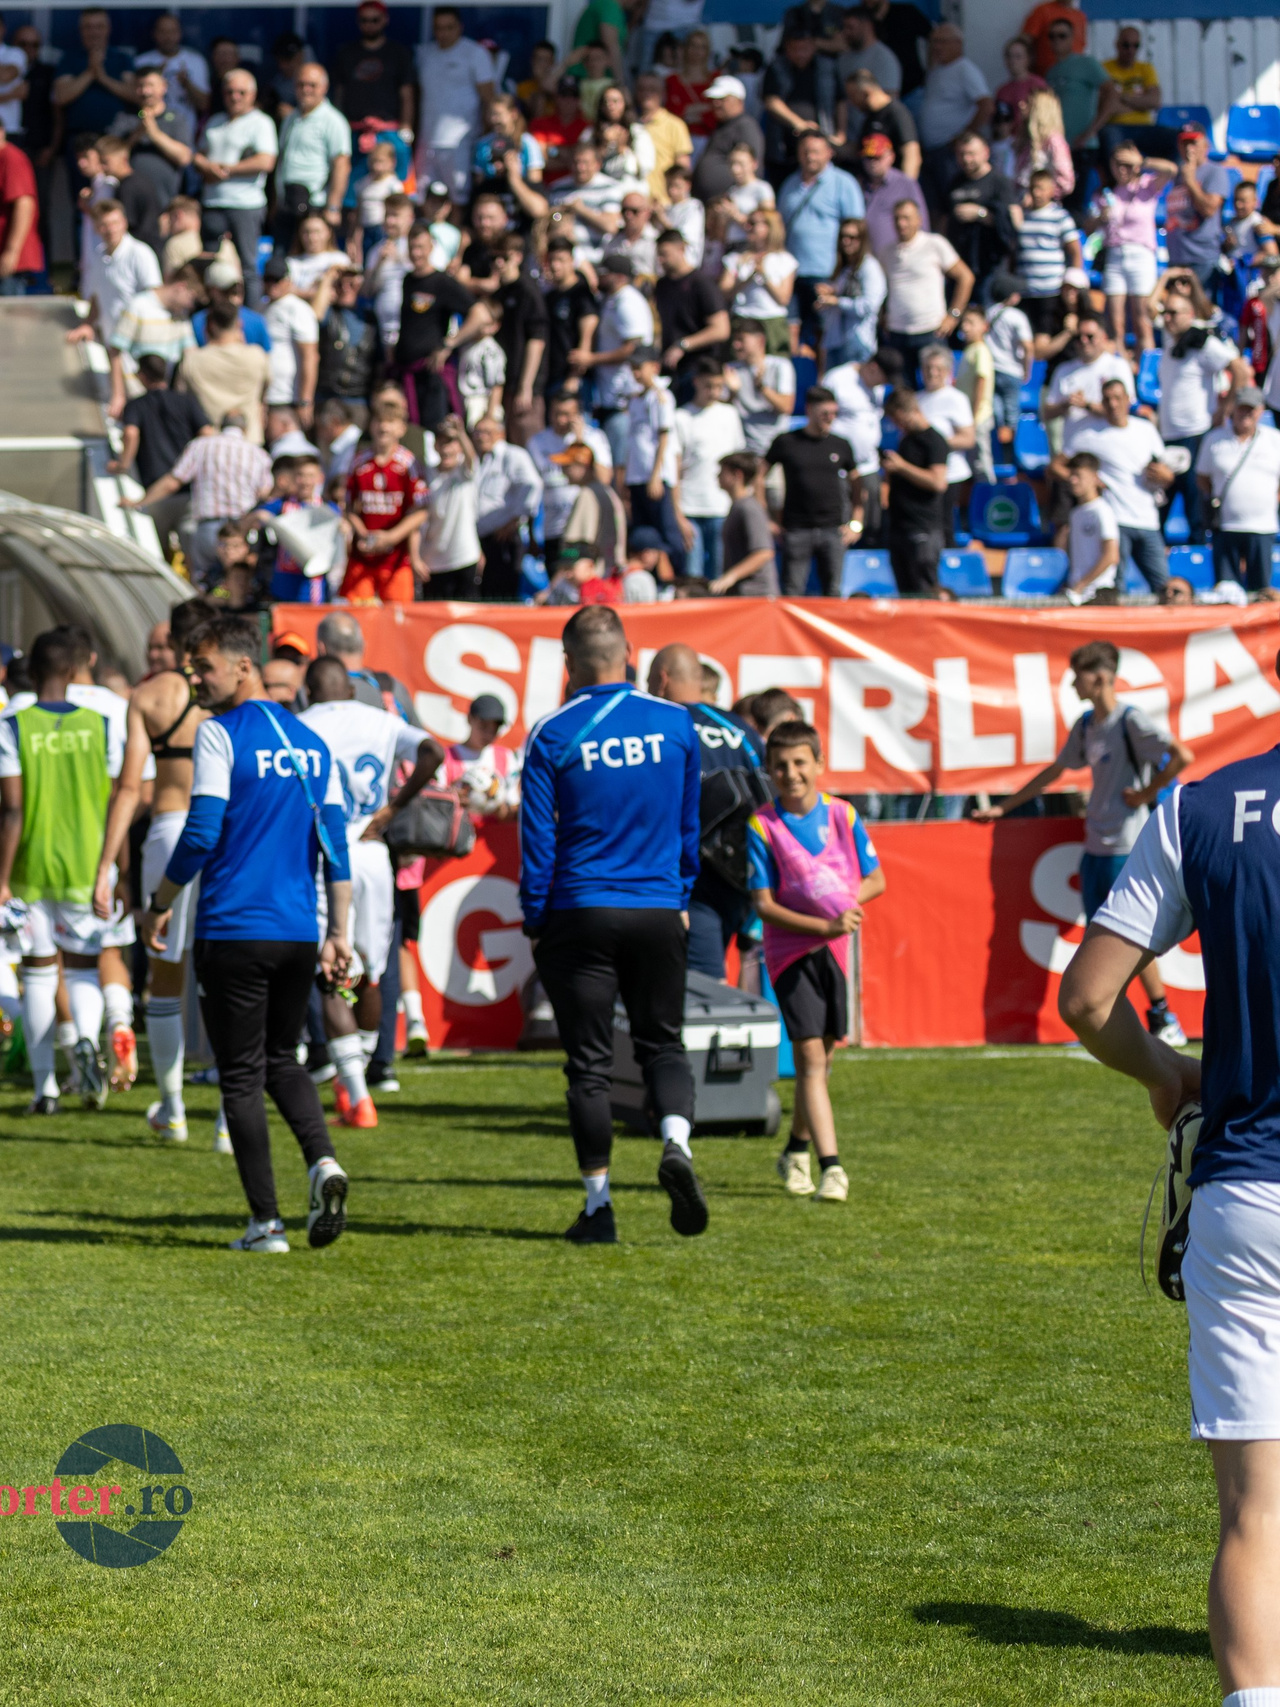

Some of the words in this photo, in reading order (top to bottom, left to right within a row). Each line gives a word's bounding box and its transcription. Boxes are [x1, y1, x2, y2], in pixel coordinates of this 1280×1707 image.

[30, 729, 93, 756] FCBT
[581, 733, 665, 772] FCBT
[693, 723, 745, 750] CV
[1232, 789, 1280, 843] F
